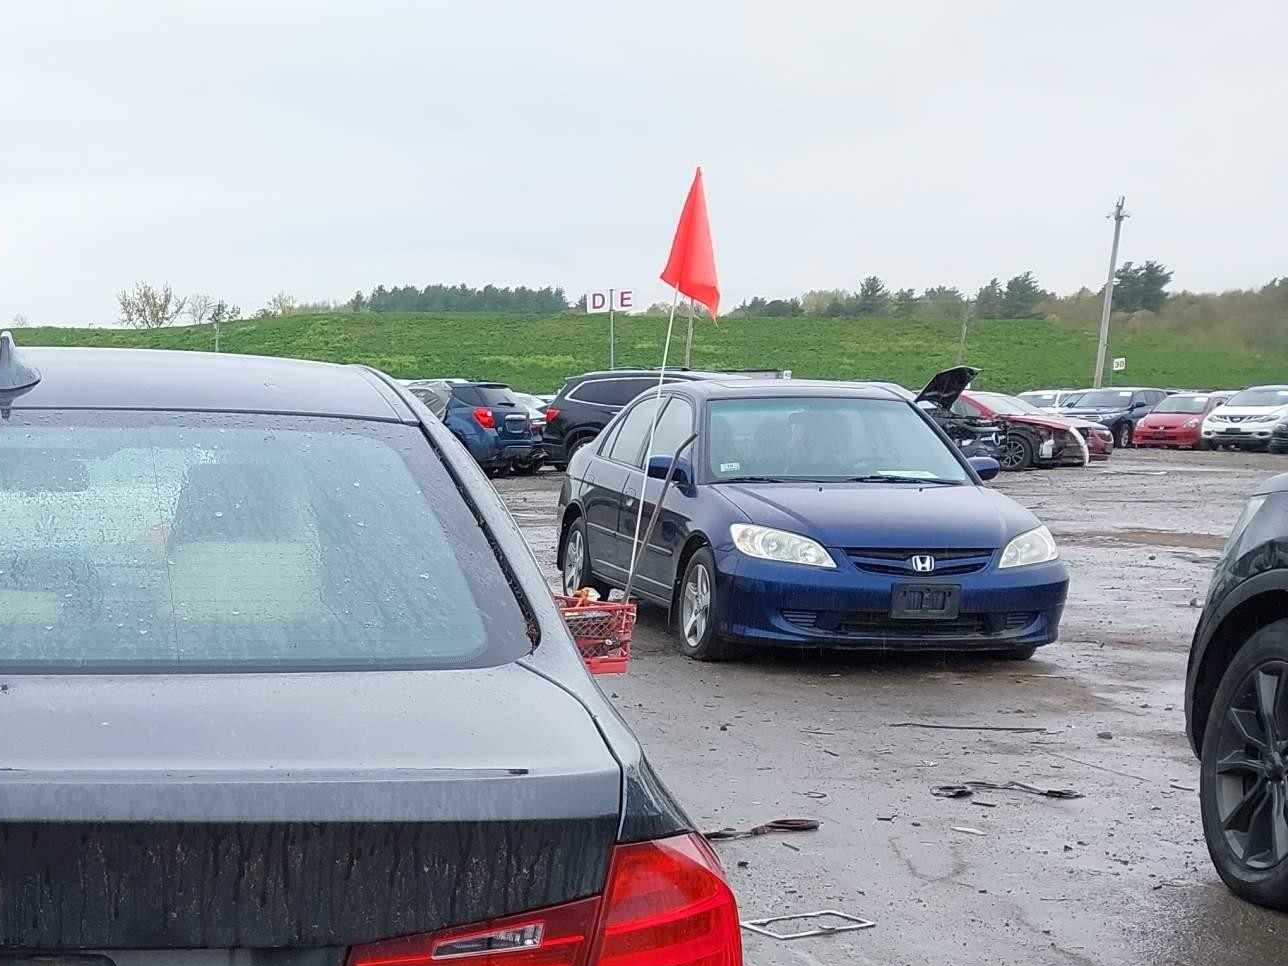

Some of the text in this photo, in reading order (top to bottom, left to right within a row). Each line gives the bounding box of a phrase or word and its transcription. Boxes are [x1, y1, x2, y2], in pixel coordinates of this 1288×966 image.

[592, 293, 606, 310] D
[620, 291, 633, 308] E
[1114, 360, 1125, 369] 30
